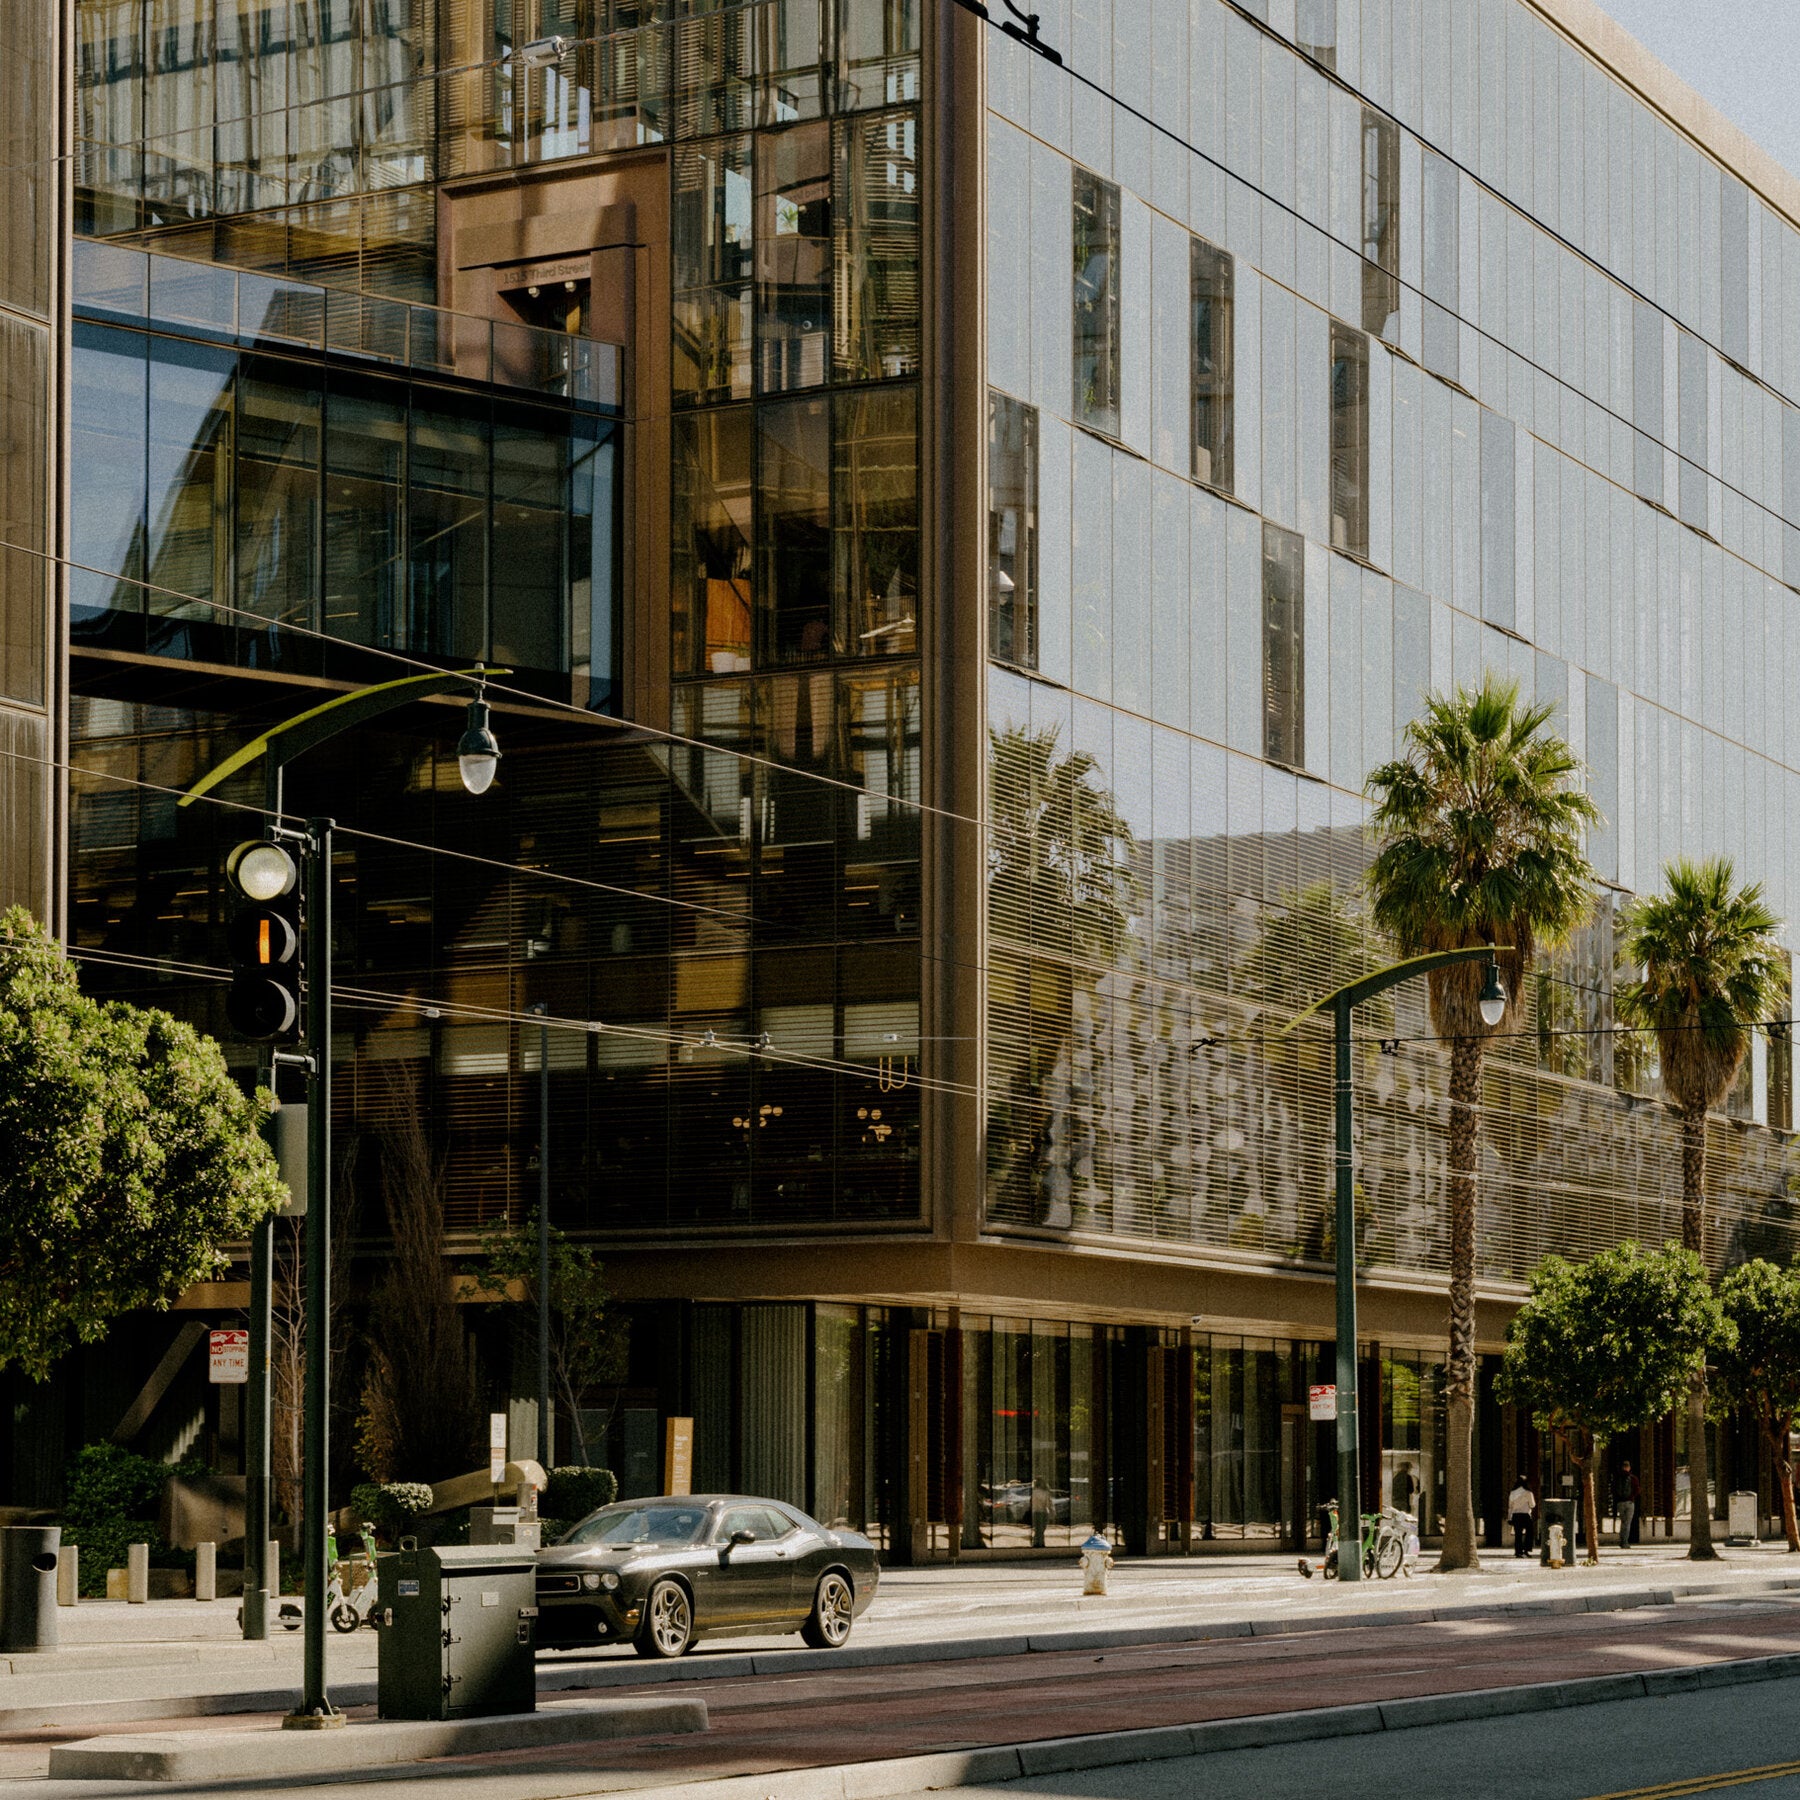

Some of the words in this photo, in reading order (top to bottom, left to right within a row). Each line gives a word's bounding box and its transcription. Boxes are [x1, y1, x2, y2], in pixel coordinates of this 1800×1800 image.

[529, 266, 556, 280] Third
[558, 262, 590, 275] Street
[211, 1345, 223, 1353] NO
[223, 1345, 246, 1353] STOPPING
[213, 1359, 226, 1368] ANY
[228, 1358, 245, 1367] TIME
